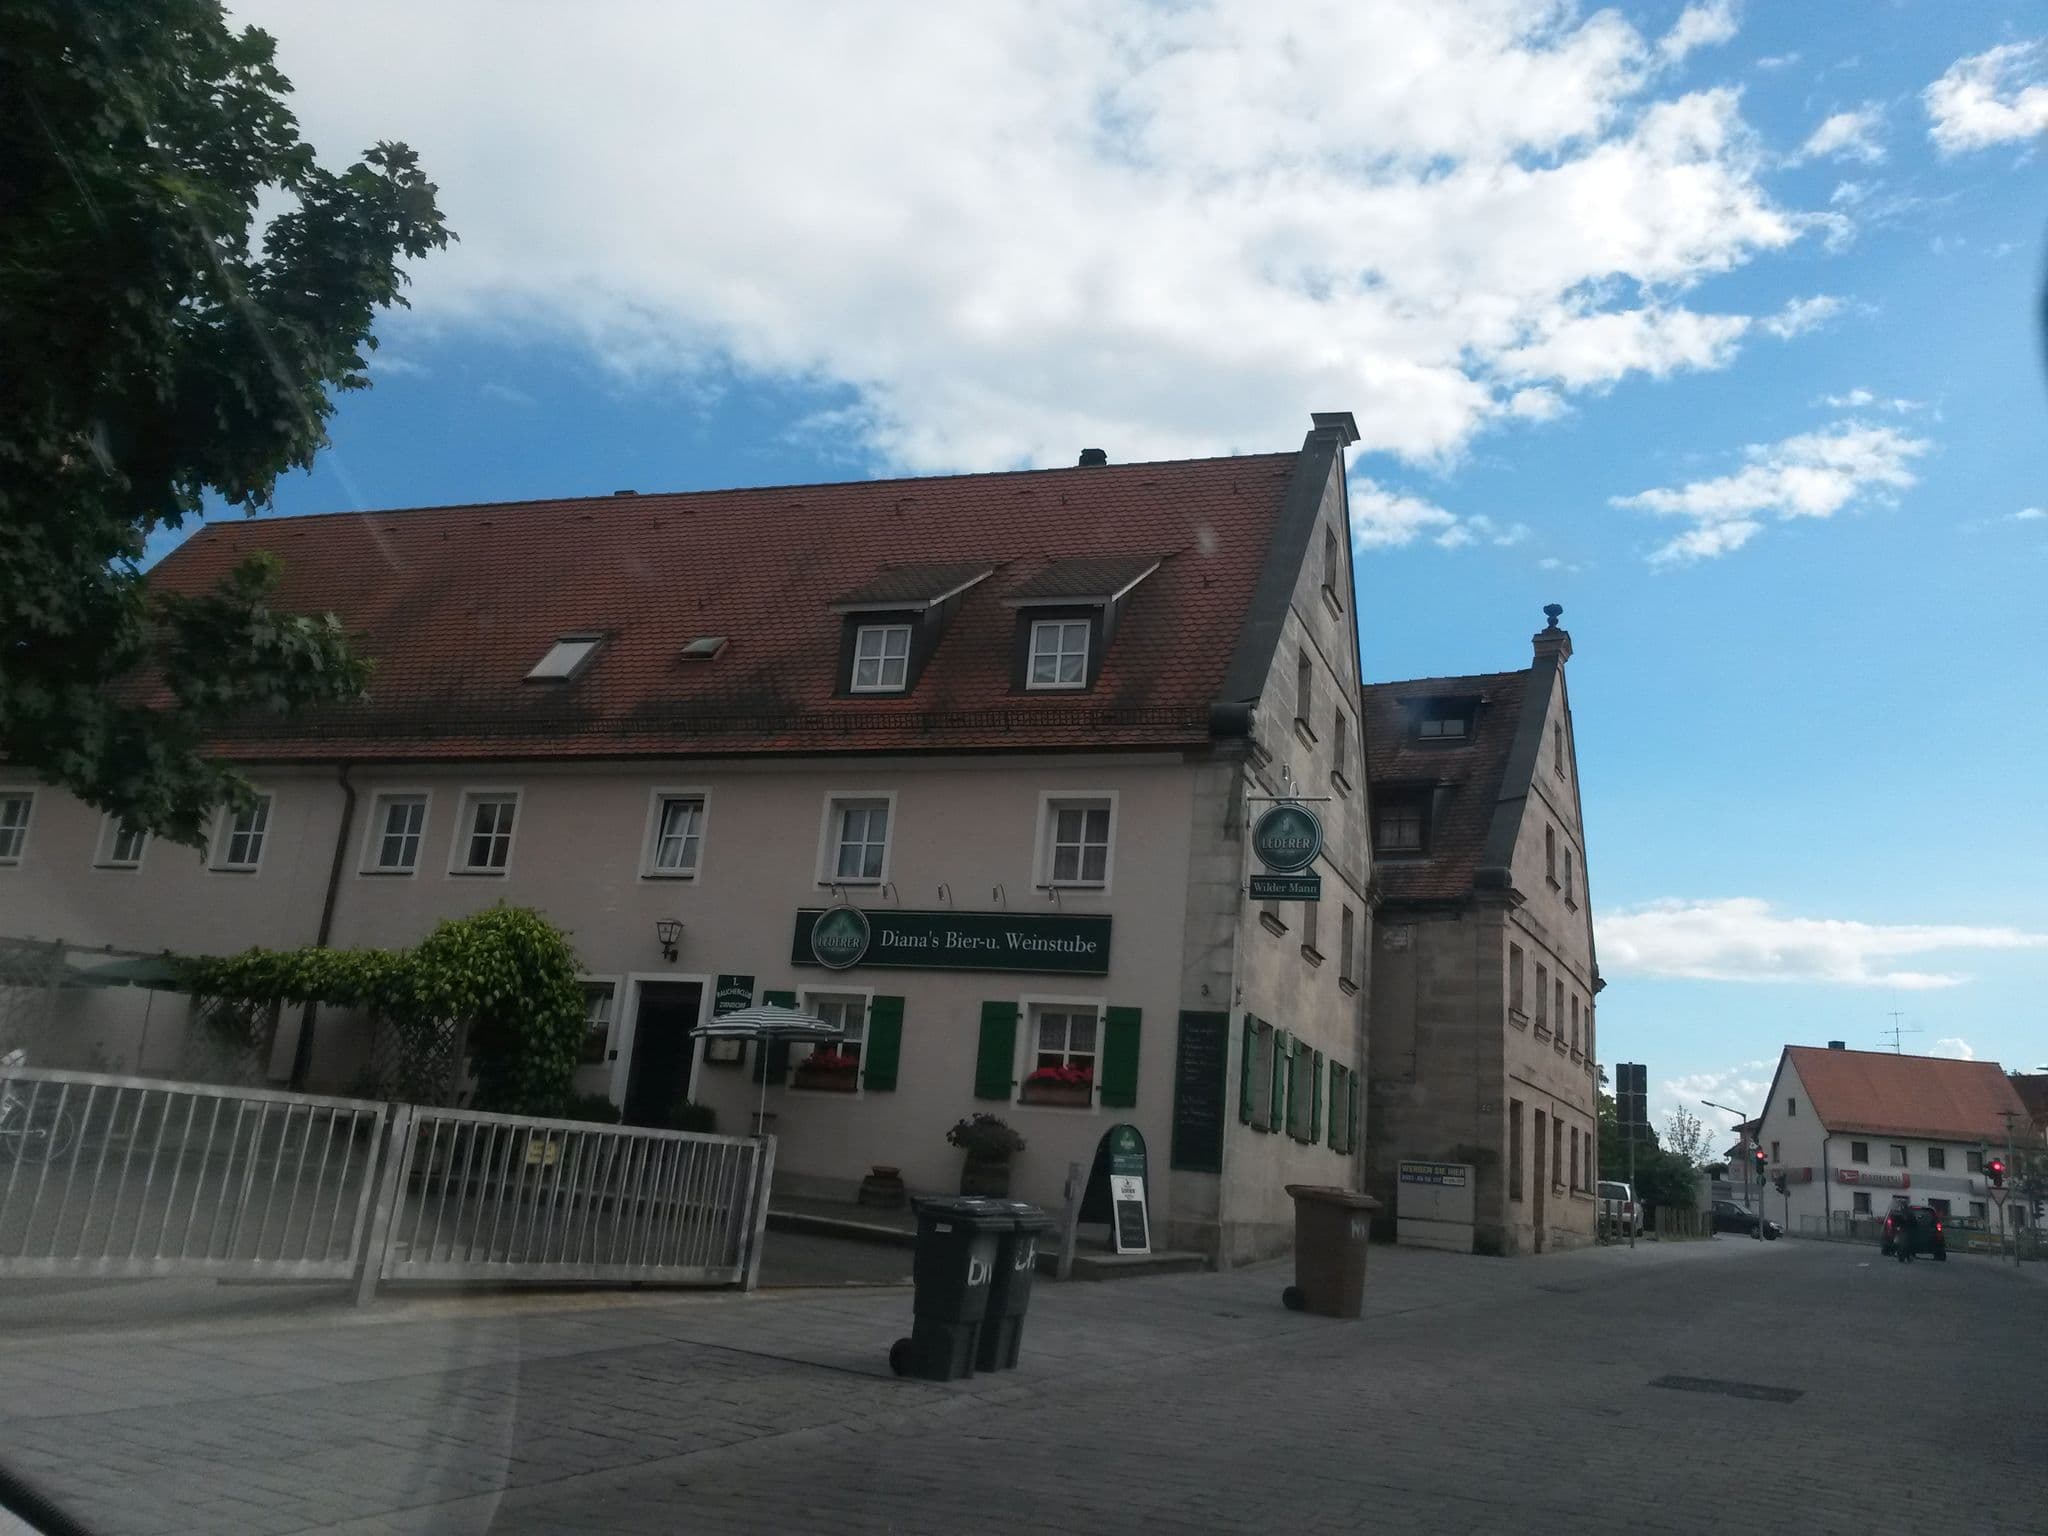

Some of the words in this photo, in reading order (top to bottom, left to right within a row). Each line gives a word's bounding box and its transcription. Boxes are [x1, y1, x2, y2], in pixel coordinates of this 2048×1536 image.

[1262, 838, 1310, 849] LEDERER
[1254, 882, 1287, 892] Wilder
[1289, 883, 1317, 893] Mann
[817, 936, 860, 949] LEDERER
[881, 930, 939, 948] Diana's
[945, 931, 1000, 949] Bier-u.
[1006, 932, 1097, 953] Weinstube
[1201, 984, 1209, 996] 3
